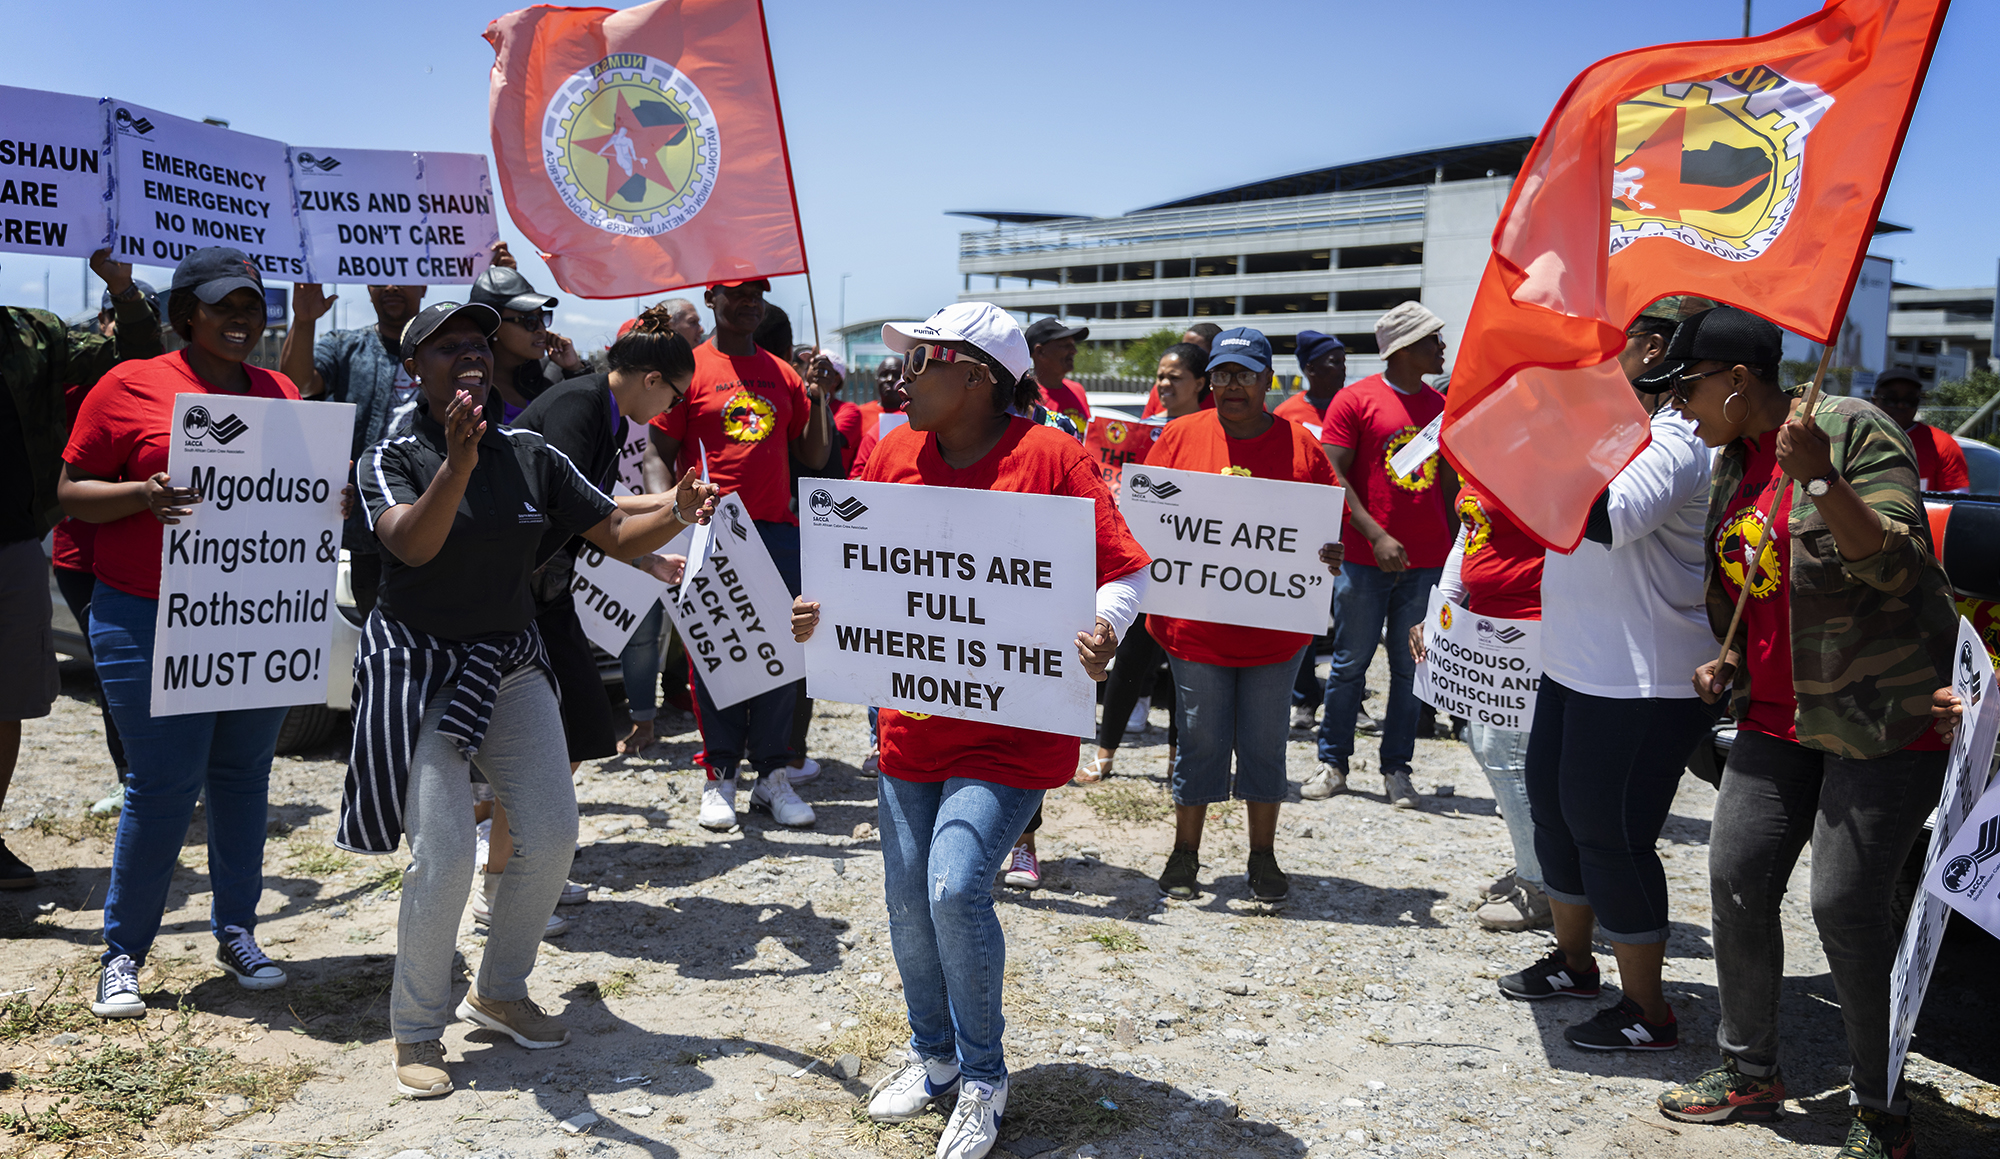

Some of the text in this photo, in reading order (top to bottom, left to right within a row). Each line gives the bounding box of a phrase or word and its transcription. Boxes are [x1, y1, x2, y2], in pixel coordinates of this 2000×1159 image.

[0, 139, 98, 174] SHAUN
[142, 150, 266, 192] EMERGENCY
[0, 179, 58, 208] ARE
[144, 179, 270, 219] EMERGENCY
[300, 190, 490, 215] ZUKS AND SHAUN
[0, 218, 68, 247] REW
[121, 235, 145, 257] IN
[155, 211, 266, 245] NO MONEY
[409, 226, 466, 246] CARE
[338, 256, 475, 278] ABOUT CREW
[913, 328, 935, 336] PUMA
[622, 438, 646, 459] HE
[191, 466, 330, 511] Mgoduso
[169, 529, 337, 573] Kingston &
[1230, 523, 1299, 554] ARE
[843, 542, 1053, 589] FLIGHTS ARE
[1150, 557, 1192, 585] OT
[167, 588, 329, 628] Rothschild
[572, 570, 637, 632] PTION
[691, 567, 731, 627] ACK
[722, 627, 748, 663] TO
[907, 590, 986, 626] FULL
[688, 623, 723, 673] USA
[757, 641, 785, 677] GO
[835, 624, 1064, 678] WHERE IS THE
[1432, 631, 1531, 674] MOGODUSO,
[163, 647, 321, 691] MUST GO!
[1425, 646, 1494, 687] KINGSTON
[892, 671, 1006, 712] MONEY
[1431, 671, 1526, 710] ROTHSCHILS
[1433, 692, 1519, 728] MUST GO!!
[1966, 875, 1986, 899] SACCA
